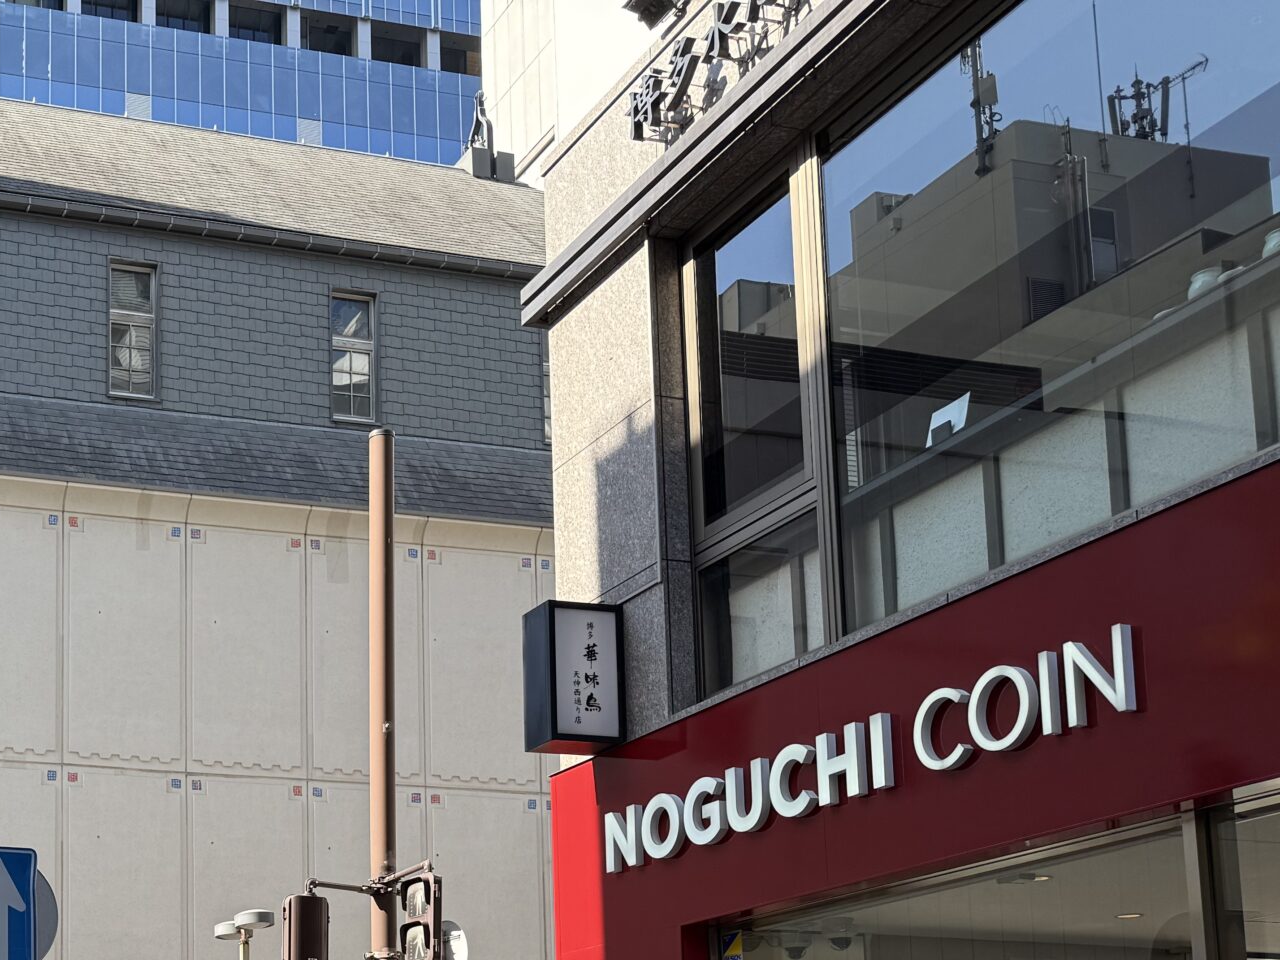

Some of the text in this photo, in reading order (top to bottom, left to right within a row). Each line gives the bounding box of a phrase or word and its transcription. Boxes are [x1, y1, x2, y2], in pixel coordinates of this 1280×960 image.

[573, 670, 583, 725] 天神西通り店
[605, 622, 1138, 874] NOGUCHI COIN
